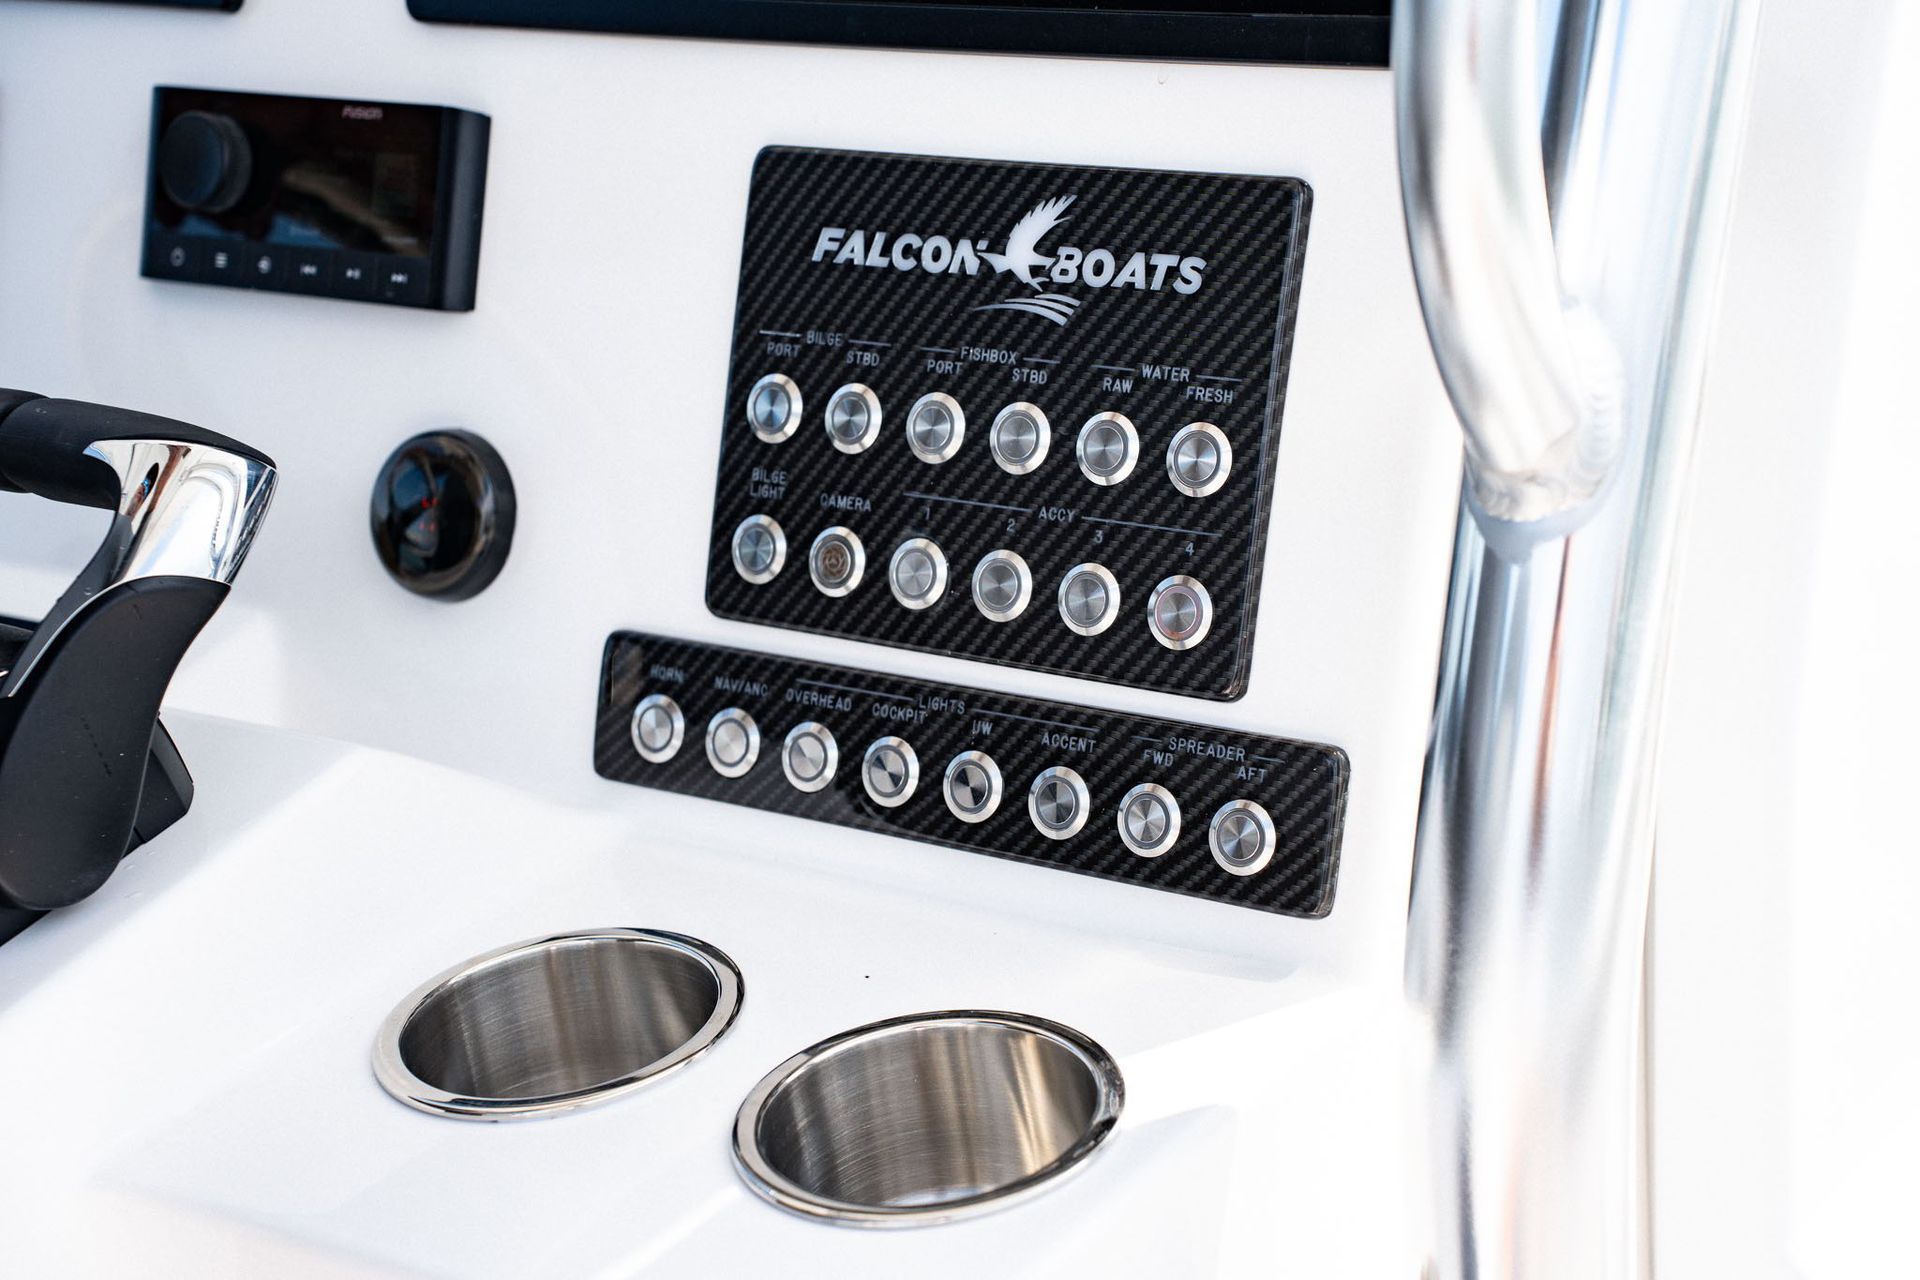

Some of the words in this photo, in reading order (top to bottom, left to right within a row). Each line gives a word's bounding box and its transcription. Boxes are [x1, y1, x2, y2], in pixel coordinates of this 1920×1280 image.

[811, 227, 989, 277] FALCON
[1050, 246, 1208, 295] BOATS
[806, 331, 843, 347] BILGE
[767, 341, 801, 359] PORT
[846, 350, 880, 367] STBD
[960, 346, 1017, 365] FISHBOX
[926, 359, 963, 375] PORT
[1011, 367, 1048, 385] STBD
[1141, 363, 1190, 382] WATER
[1102, 377, 1134, 394] RAW
[1186, 386, 1234, 404] FRESH
[751, 467, 788, 485] BILGE
[750, 483, 786, 499] LIGHT
[820, 492, 872, 512] CAMERA
[924, 506, 931, 520] 1
[1038, 506, 1076, 523] ACCY
[1006, 518, 1016, 533] 2
[1094, 529, 1104, 544] 3
[1185, 542, 1195, 557] 4
[650, 664, 684, 684] HORN
[714, 675, 768, 697] NAV/ANC
[785, 688, 852, 712] OVERHEAD
[918, 695, 965, 715] LIGHTS
[872, 702, 926, 724] COCKPIT
[972, 719, 993, 735] UW
[1041, 731, 1097, 753] ACCENT
[1168, 736, 1246, 763] SPREADER
[1142, 749, 1174, 767] FWD
[1235, 765, 1268, 783] AFT
